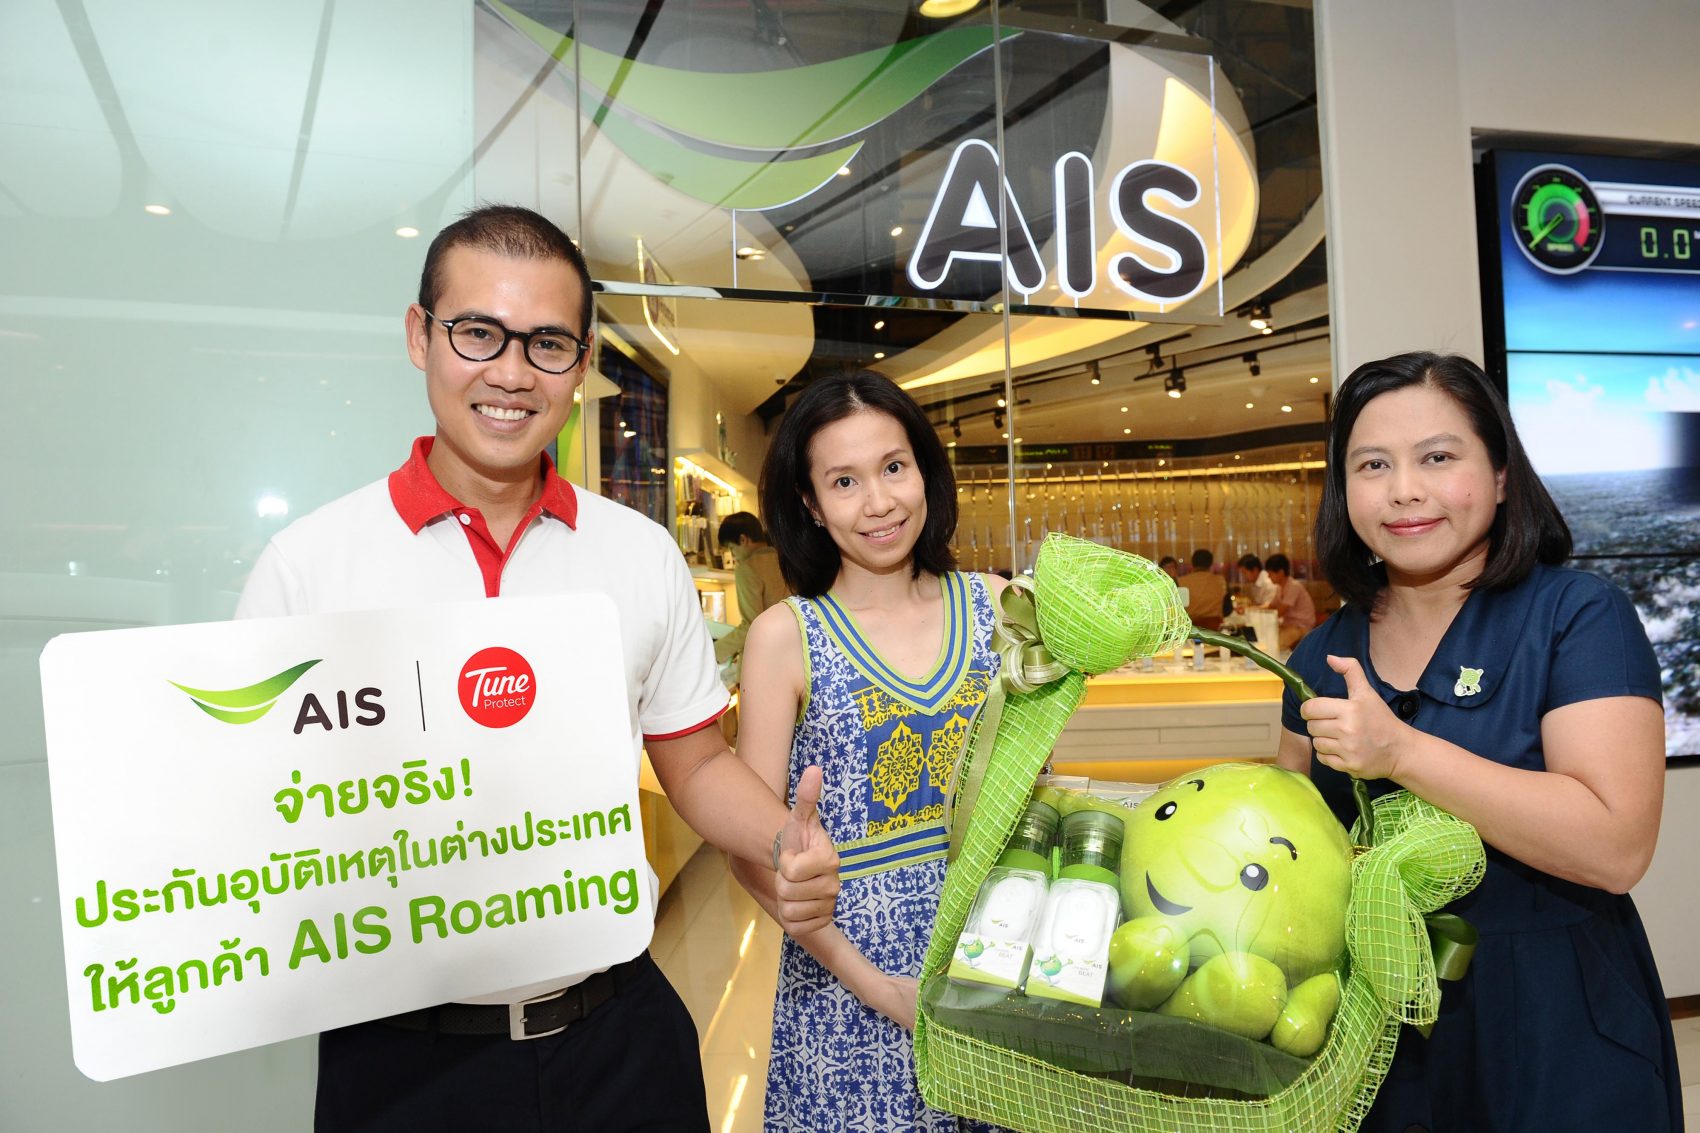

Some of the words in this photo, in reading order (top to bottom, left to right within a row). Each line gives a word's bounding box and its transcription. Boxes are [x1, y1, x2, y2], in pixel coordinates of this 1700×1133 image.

[907, 138, 1208, 304] AIS
[1641, 227, 1690, 259] 0.0
[293, 686, 386, 734] AIS
[465, 666, 530, 708] Tune
[484, 696, 526, 709] Protect
[273, 757, 473, 824] จ่ายจริง!
[75, 803, 633, 928] ประกันอุบัติเหตุในต่างประเทศ
[83, 937, 270, 1015] ให้ลูกค้า
[288, 905, 392, 971] AIS
[408, 868, 640, 945] Roaming
